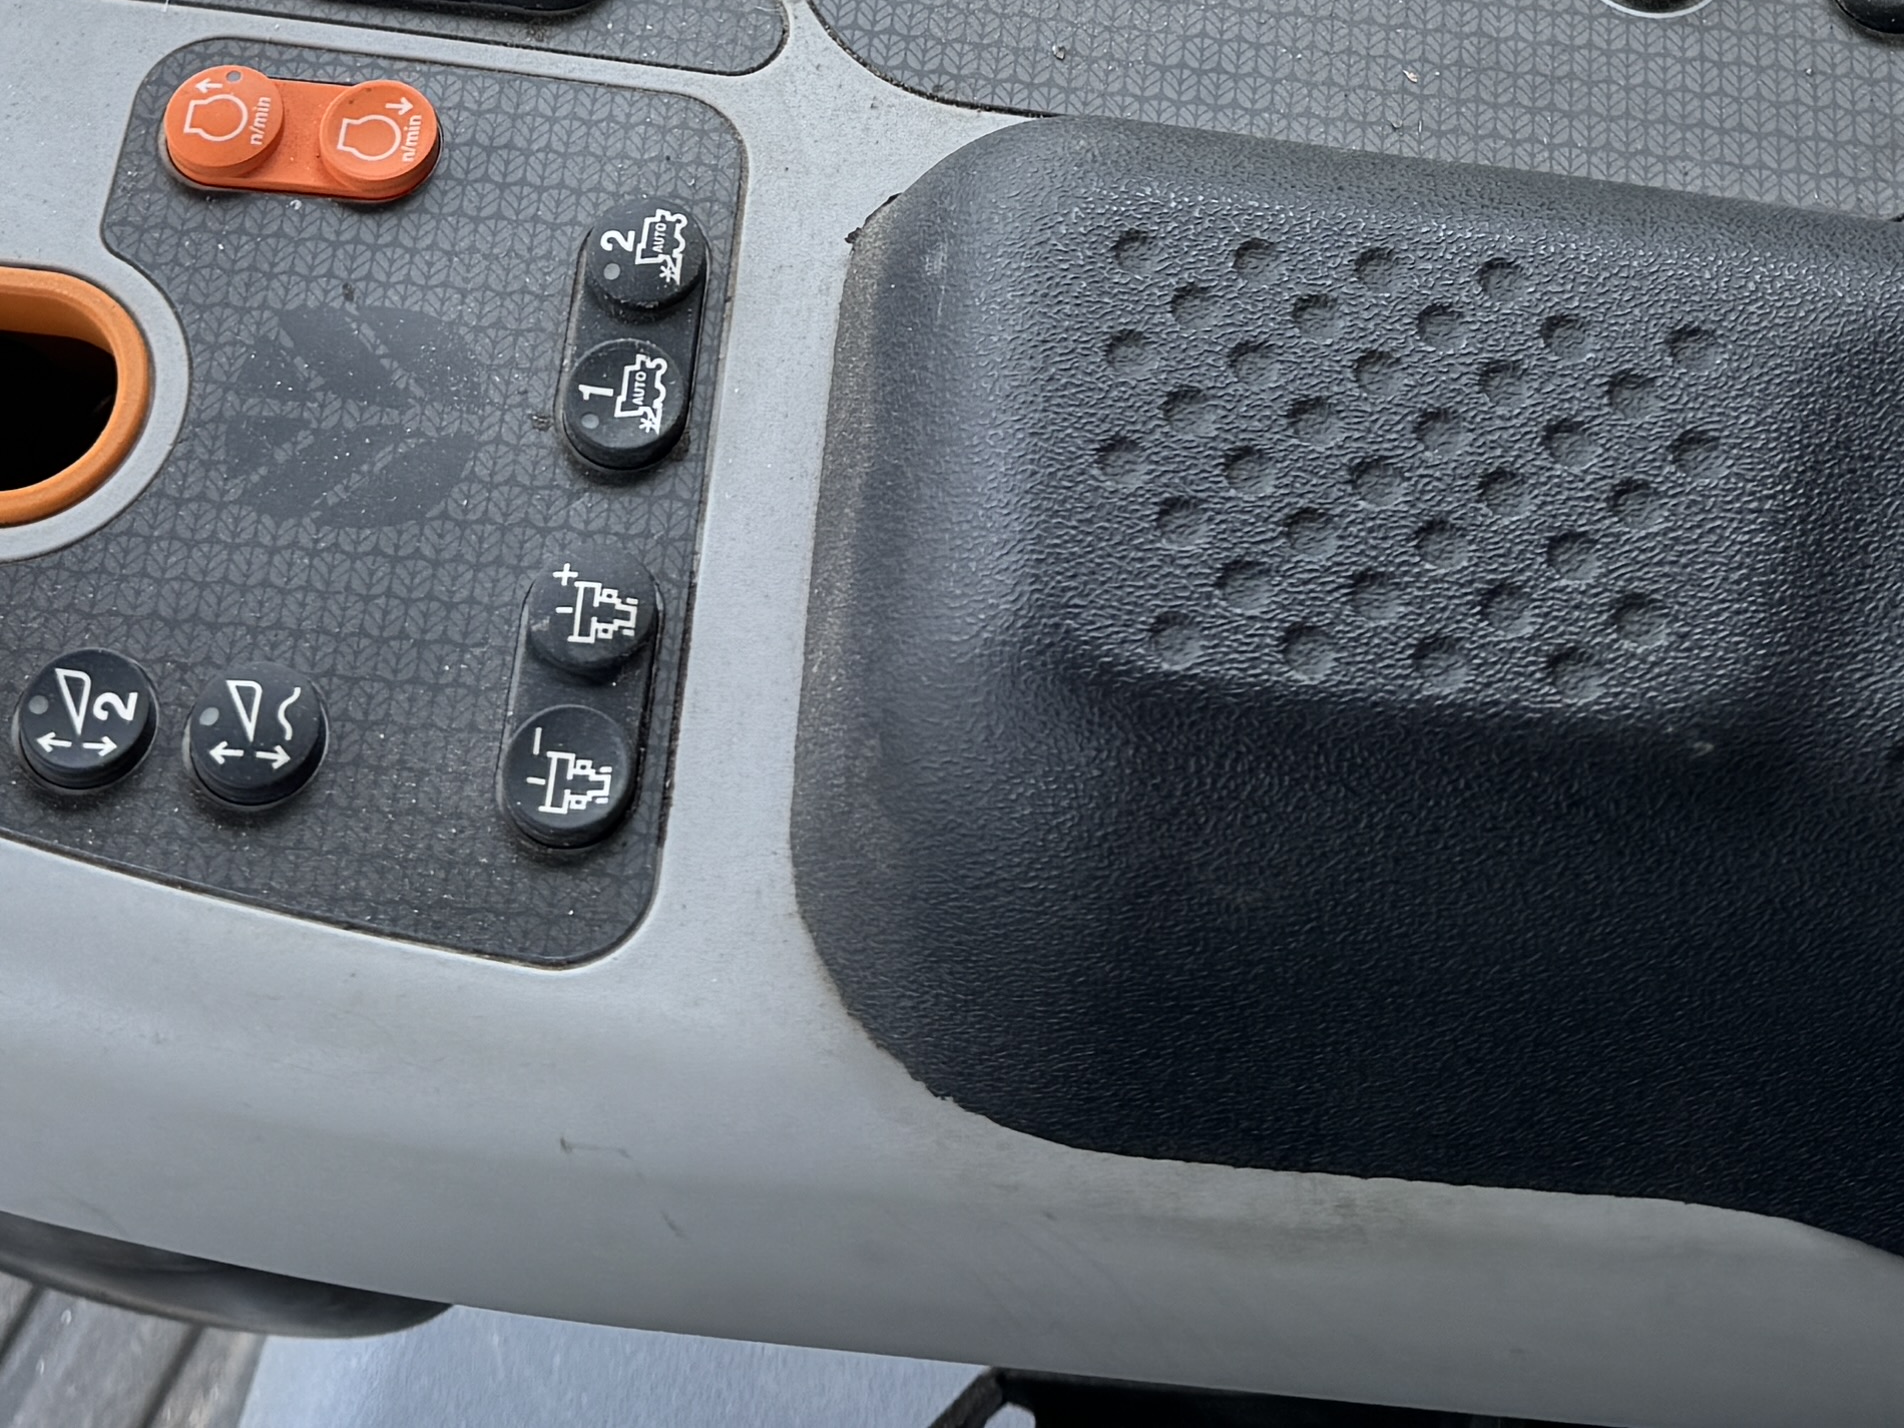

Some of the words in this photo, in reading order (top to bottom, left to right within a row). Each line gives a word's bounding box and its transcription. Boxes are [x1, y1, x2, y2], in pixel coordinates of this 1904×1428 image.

[249, 96, 272, 146] n/min
[401, 114, 423, 163] n/min
[600, 230, 636, 252] 2
[652, 223, 666, 253] AUTO
[578, 384, 614, 400] 1
[632, 371, 646, 406] AUTO
[93, 691, 139, 722] 2
